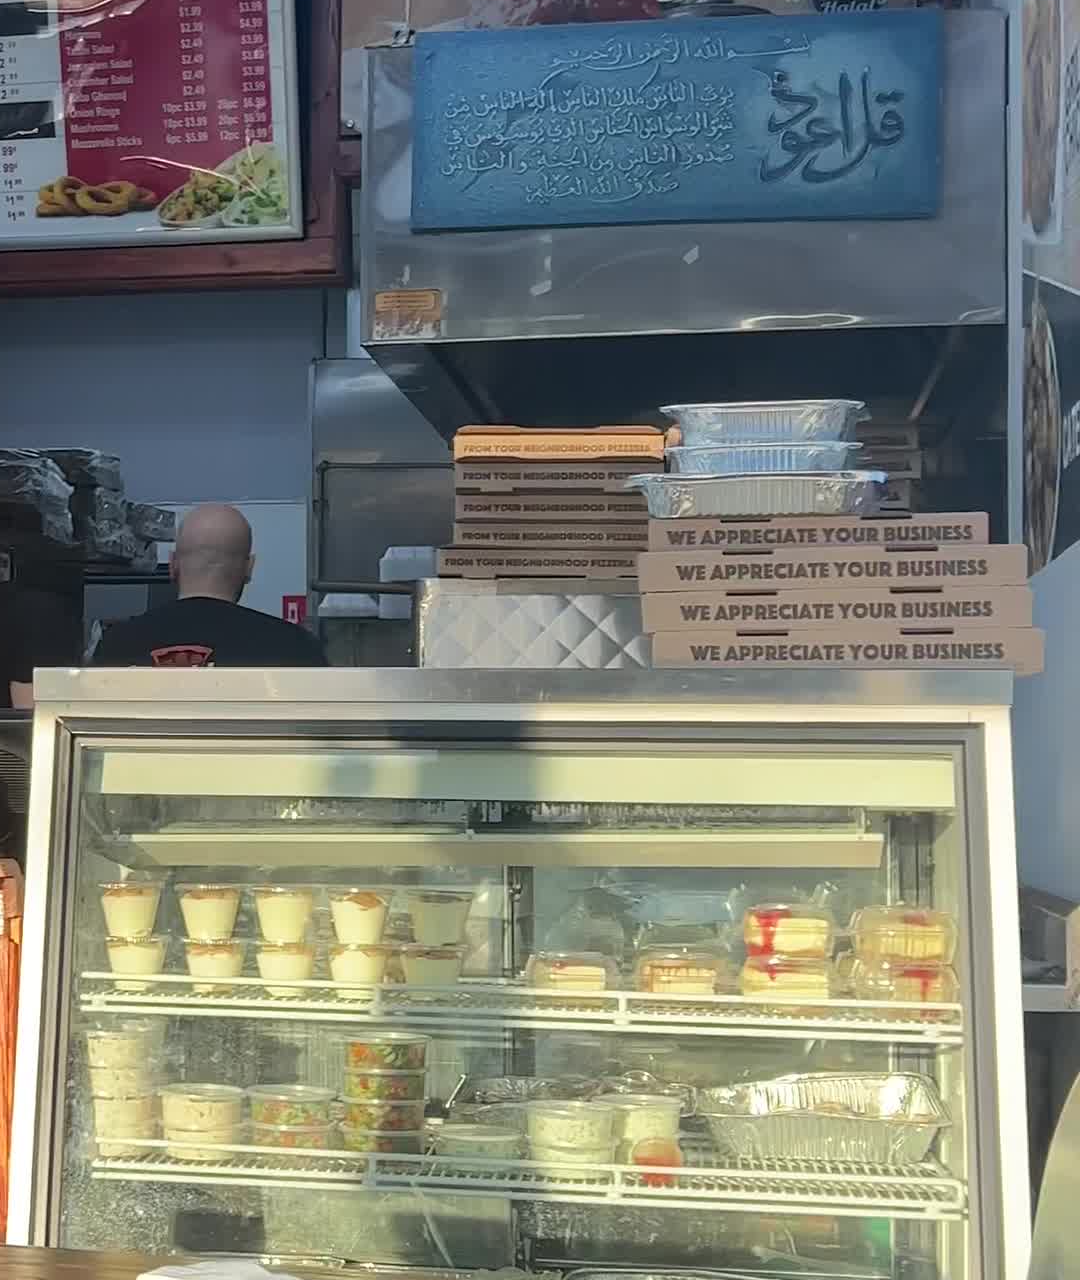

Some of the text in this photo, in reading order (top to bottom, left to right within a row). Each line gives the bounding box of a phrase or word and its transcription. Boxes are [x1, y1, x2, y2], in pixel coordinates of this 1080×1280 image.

[667, 525, 972, 545] WE APPRECIATE YOUR BUSINESS
[676, 560, 988, 581] WE APPRECIATE YOUR BUSINESS
[680, 601, 993, 621] WE APPRECIATE YOUR BUSINESS
[690, 643, 1004, 662] WE APPRECIATE YOUR BUSINESS
